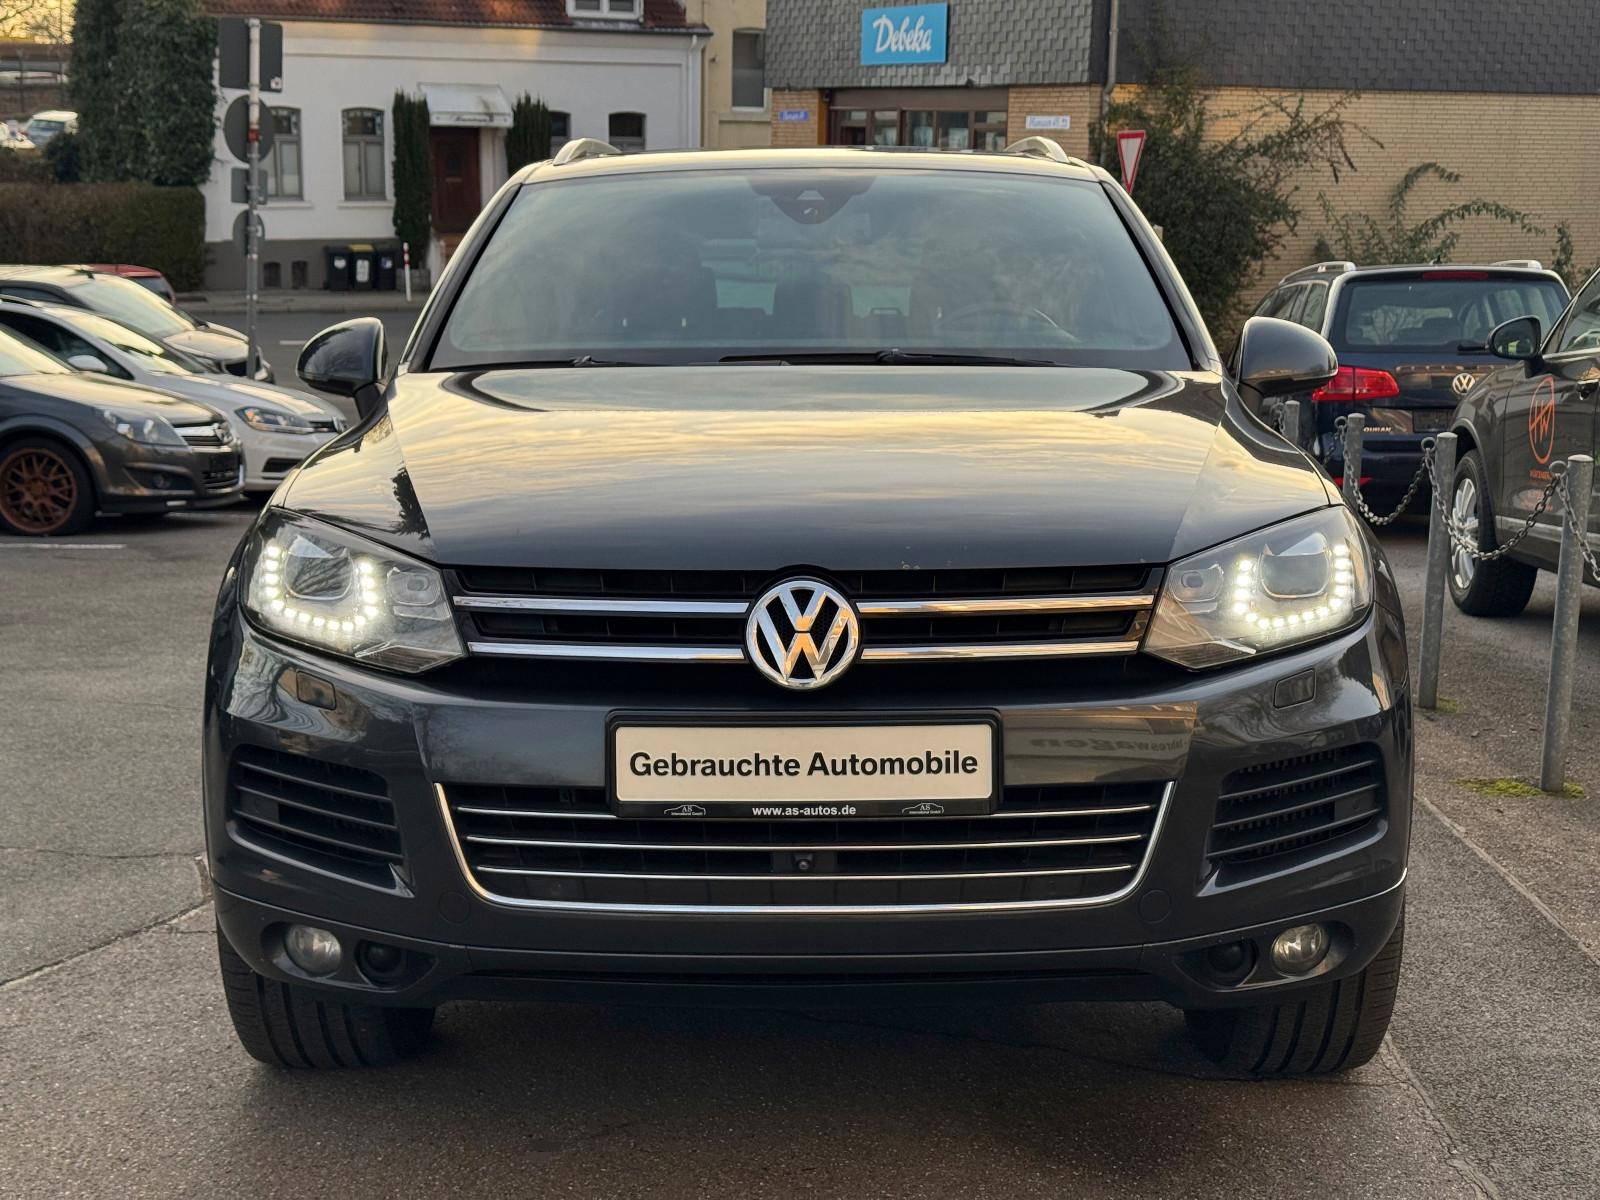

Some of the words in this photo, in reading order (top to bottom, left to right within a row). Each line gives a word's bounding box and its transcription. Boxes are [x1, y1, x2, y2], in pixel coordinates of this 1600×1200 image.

[872, 14, 932, 53] Debeka
[1453, 373, 1475, 395] VW
[748, 579, 858, 688] VW
[629, 751, 801, 777] Gebrauchte
[807, 750, 978, 776] Automobile
[752, 804, 857, 816] www.as-autos.de
